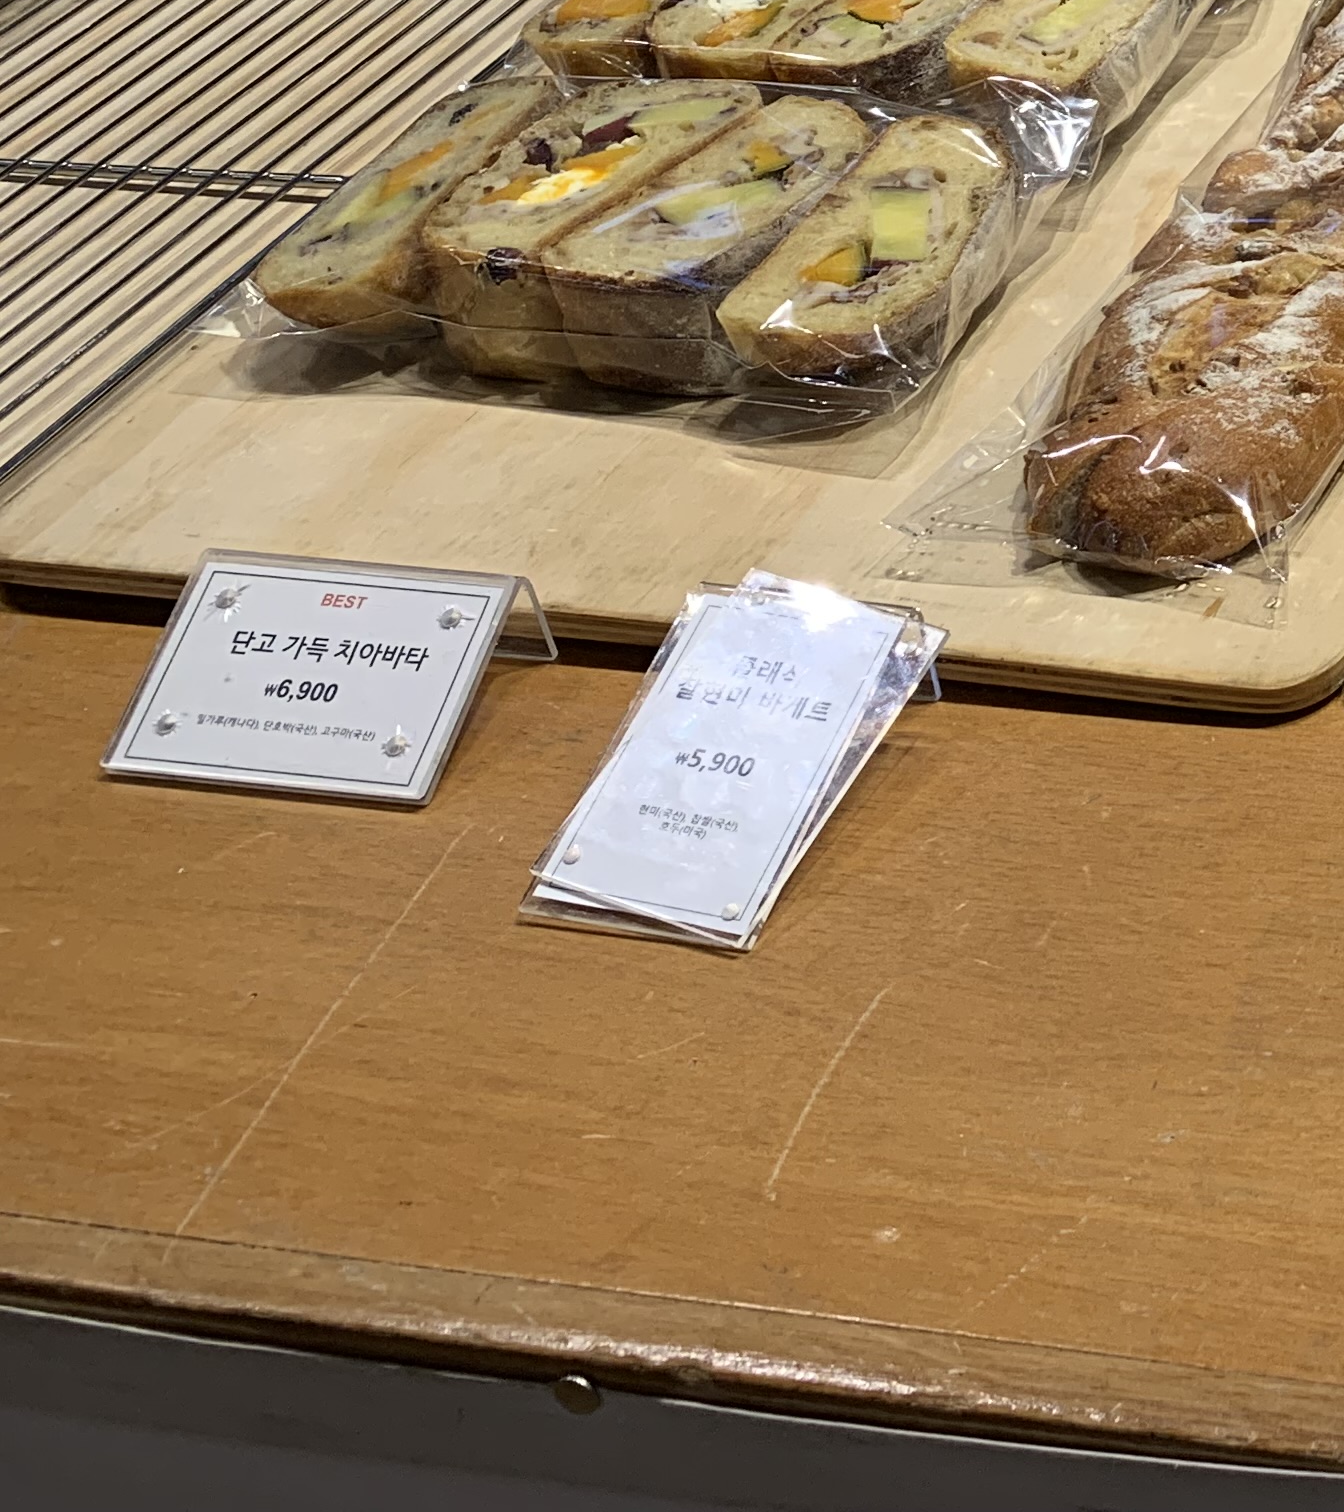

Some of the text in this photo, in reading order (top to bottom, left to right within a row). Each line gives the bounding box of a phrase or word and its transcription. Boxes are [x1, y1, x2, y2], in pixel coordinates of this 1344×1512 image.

[320, 593, 368, 609] BEST
[231, 630, 430, 672] 단고 가득 치아바타
[264, 678, 339, 703] ₩6,900
[675, 748, 756, 777] ₩5,900
